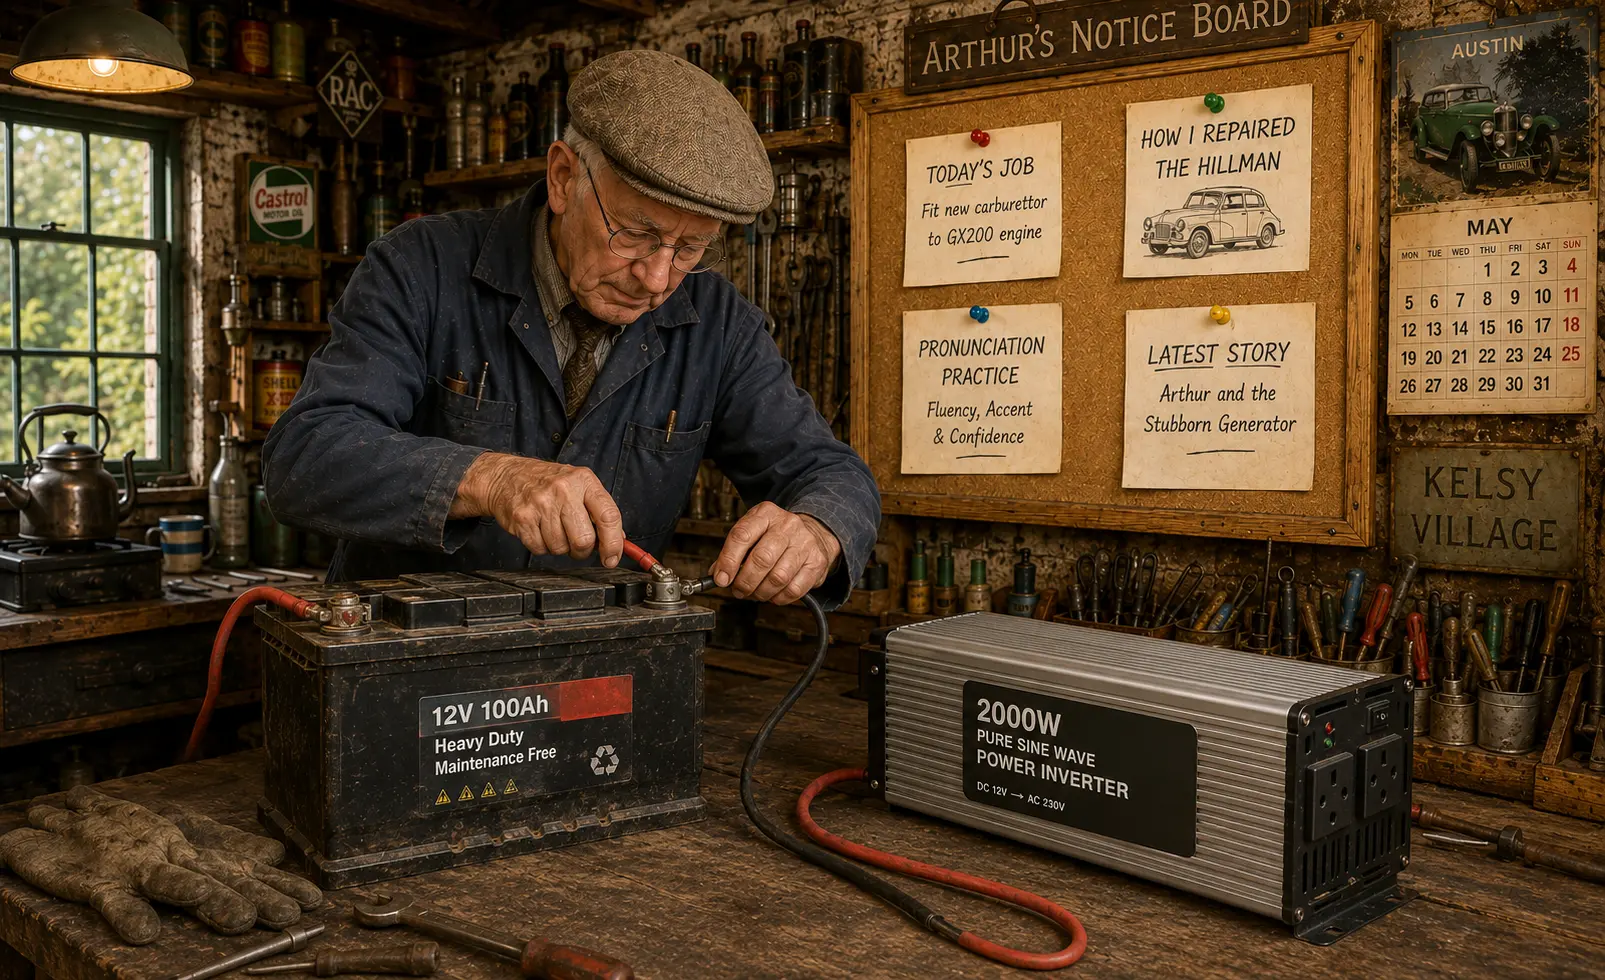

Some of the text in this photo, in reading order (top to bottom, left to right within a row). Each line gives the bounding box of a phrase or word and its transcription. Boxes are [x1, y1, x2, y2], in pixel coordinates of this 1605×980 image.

[921, 0, 1292, 77] ARTHUR'S NOTICE BOARD
[1452, 35, 1524, 60] AUSTIN
[330, 75, 374, 112] RAC
[1141, 117, 1296, 149] HOW I REPAIRED
[927, 156, 1035, 184] TODAY'S JOB
[1156, 151, 1281, 179] THE HILLMAN
[255, 187, 308, 209] Castrol
[921, 196, 1047, 219] Fit new carburettor
[928, 225, 1042, 247] to GX200 engine
[1467, 217, 1514, 237] MAY
[1401, 251, 1419, 260] MON
[1427, 249, 1442, 258] TUE
[1452, 248, 1470, 256] WED
[1480, 246, 1497, 254] THU
[1535, 242, 1551, 251] SAT
[1563, 240, 1581, 249] SUN
[1484, 258, 1577, 277] 1 2 3 4
[1405, 287, 1579, 310] 5 6 7 8 9 10 11
[1401, 317, 1580, 337] 12 13 14 15 16 17 18
[919, 336, 1045, 358] PRONUNCIATION
[1148, 342, 1291, 365] LATEST STORY
[1401, 346, 1580, 366] 19 20 21 22 23 24 25
[263, 377, 298, 389] SHELL
[942, 367, 1019, 386] PRACTICE
[1400, 376, 1550, 393] 26 27 28 29 30 31
[1160, 383, 1276, 403] Arthur and the
[927, 401, 1033, 423] Fluency, Accent
[1144, 414, 1297, 434] Stubborn Generator
[933, 427, 1024, 448] & Confidence
[1424, 466, 1543, 501] KELSY
[1411, 514, 1558, 552] VILLAGE
[432, 695, 549, 727] 12V 100Ah
[977, 698, 1062, 737] 2000W
[435, 730, 524, 754] Heavy Duty
[977, 729, 1096, 768] PURE SINE WAVE
[435, 747, 557, 776] Maintenance Free
[977, 749, 1129, 800] POWER INVERTER
[977, 781, 1066, 812] DC 12V AC 230V
